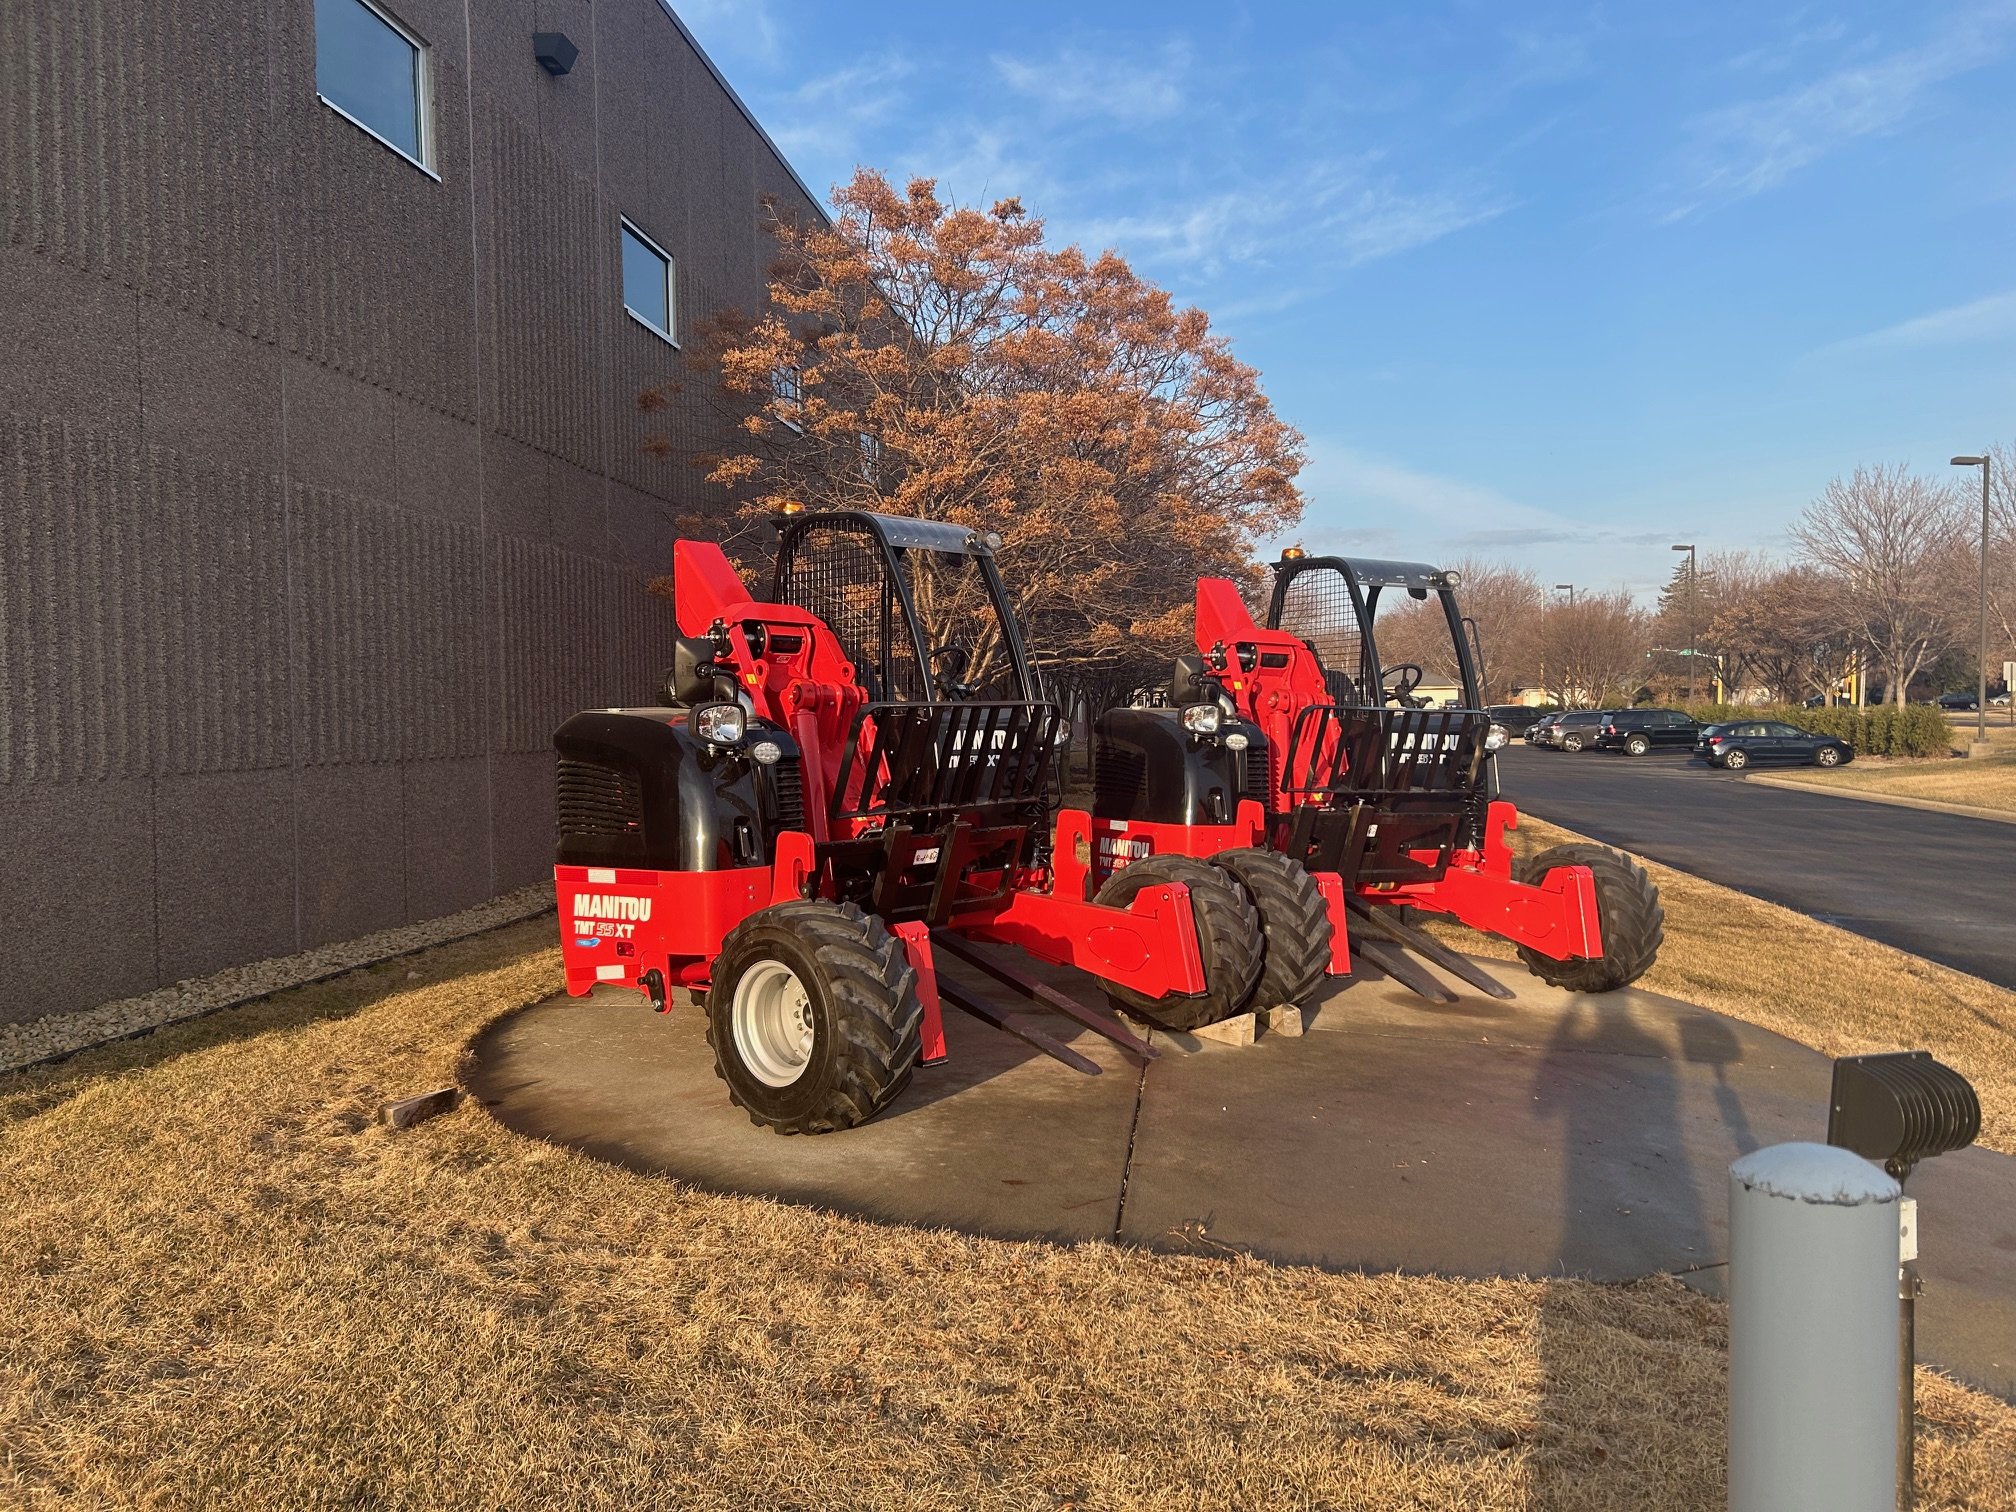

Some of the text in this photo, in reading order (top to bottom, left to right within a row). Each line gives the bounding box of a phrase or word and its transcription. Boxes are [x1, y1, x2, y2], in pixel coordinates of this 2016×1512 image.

[1099, 837, 1150, 858] MANITOU
[574, 893, 652, 922] MANITOU
[574, 920, 596, 935] TMT
